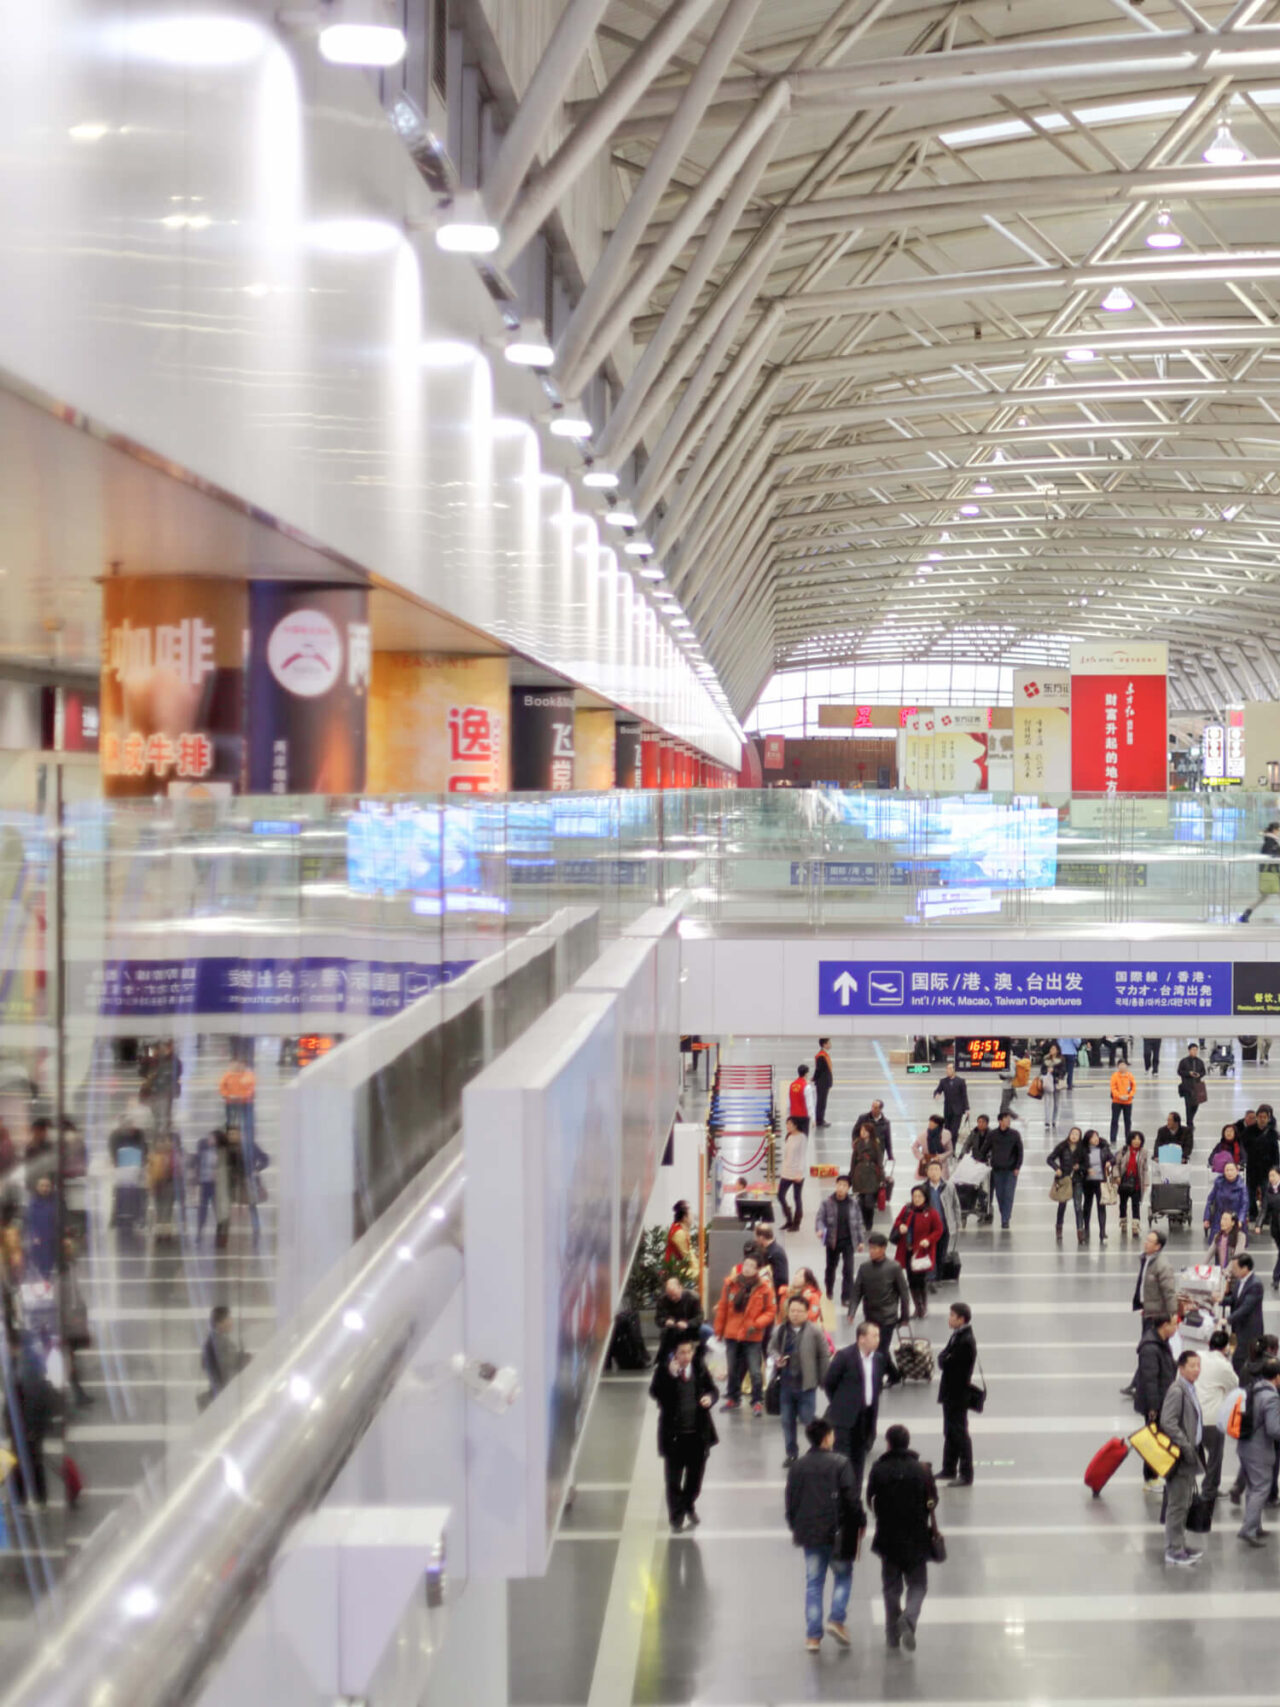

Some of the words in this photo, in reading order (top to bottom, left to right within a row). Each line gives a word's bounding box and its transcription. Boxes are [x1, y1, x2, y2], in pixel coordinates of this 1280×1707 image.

[1105, 693, 1118, 796] 财富升起的地方
[912, 972, 1083, 992] 国际/港、澳、台出发
[938, 996, 956, 1007] HK,
[958, 996, 993, 1007] Macao,
[995, 996, 1028, 1006] Taiwan
[1029, 996, 1082, 1007] Departures
[968, 1040, 1000, 1052] 16:57
